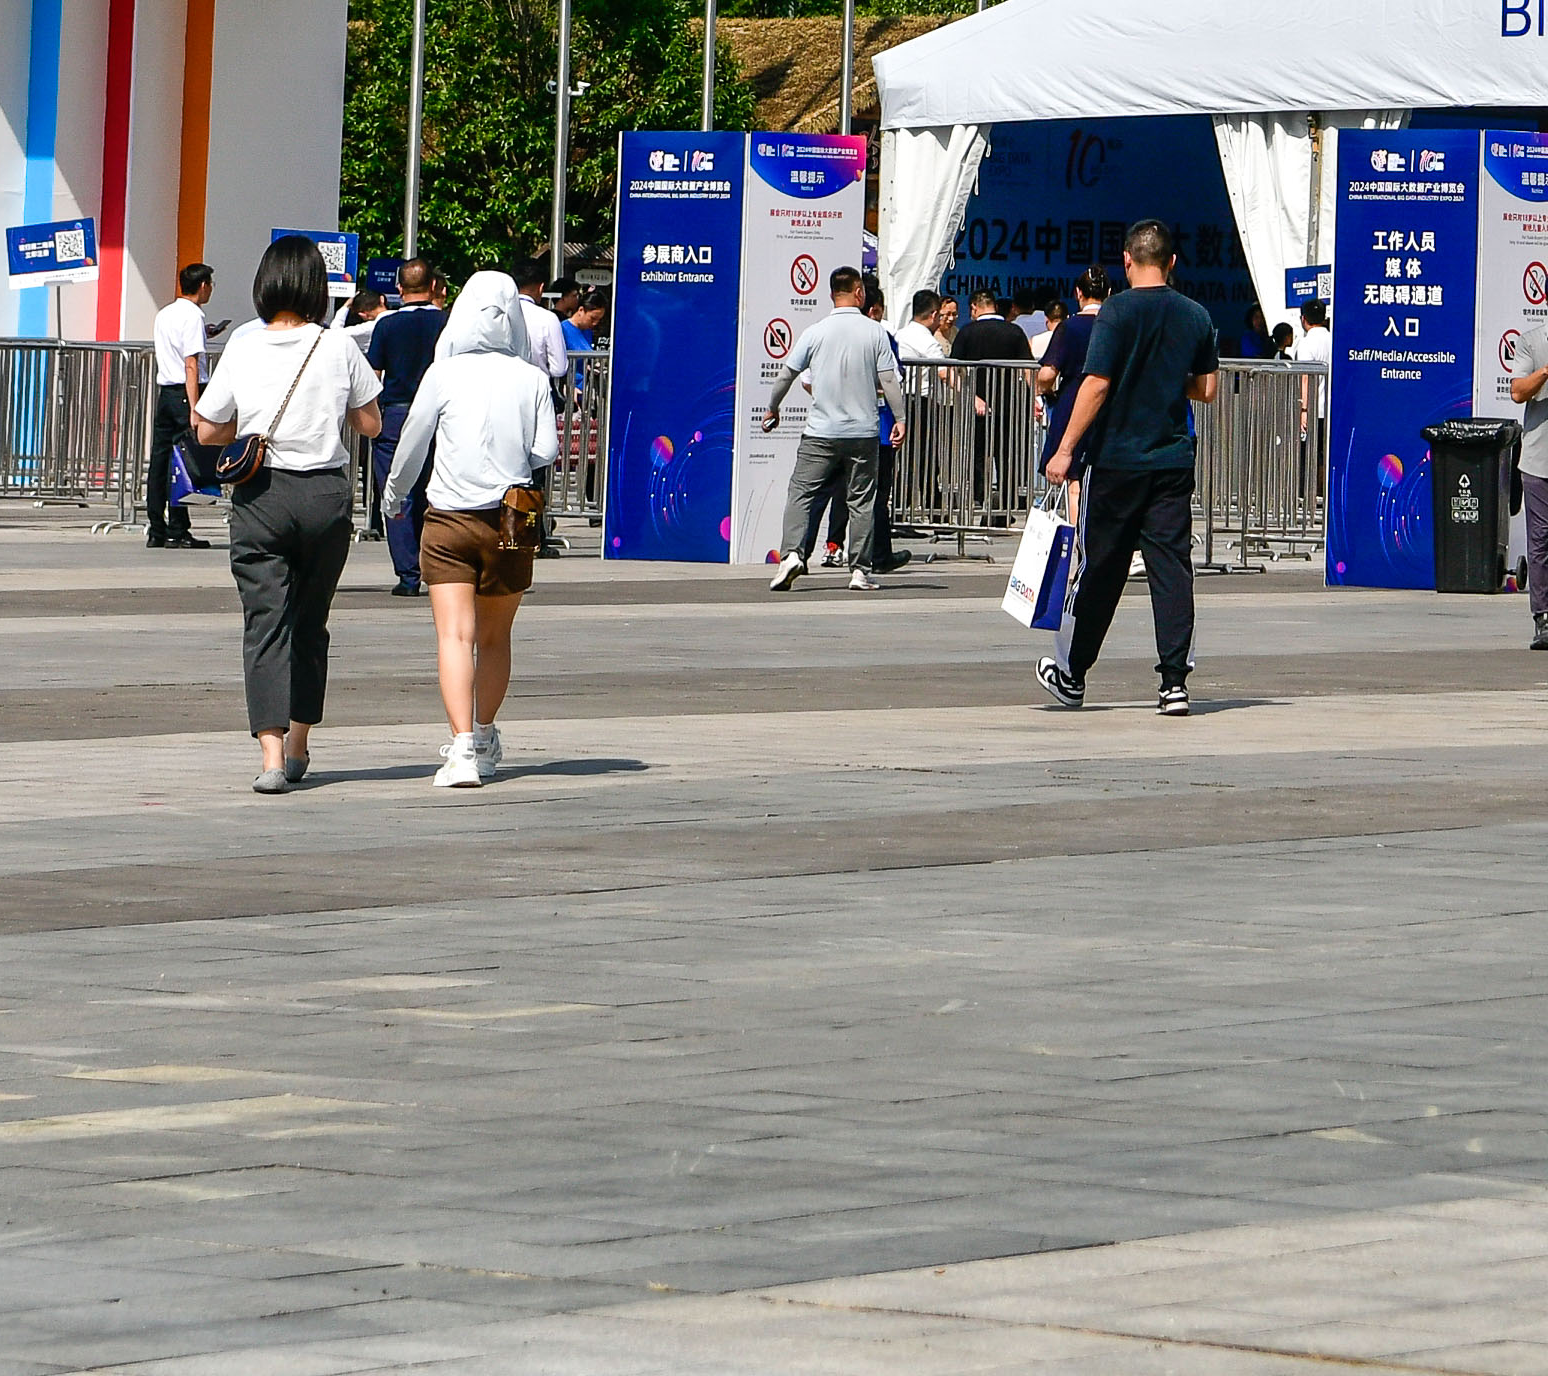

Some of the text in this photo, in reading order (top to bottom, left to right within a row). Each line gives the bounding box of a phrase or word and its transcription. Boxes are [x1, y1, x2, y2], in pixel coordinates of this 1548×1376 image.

[630, 180, 731, 191] 2024中国国际大数据产业博览会
[1349, 181, 1465, 194] 2024中国国际大数据产业博览会
[1372, 231, 1435, 252] 工作人员
[642, 244, 712, 264] 参展商入口
[641, 270, 714, 283] Exhibitor Entrance
[1364, 284, 1443, 306] 无障碍通道
[1349, 350, 1456, 364] Staff/Media/Accessible
[1381, 368, 1422, 380] Entrance
